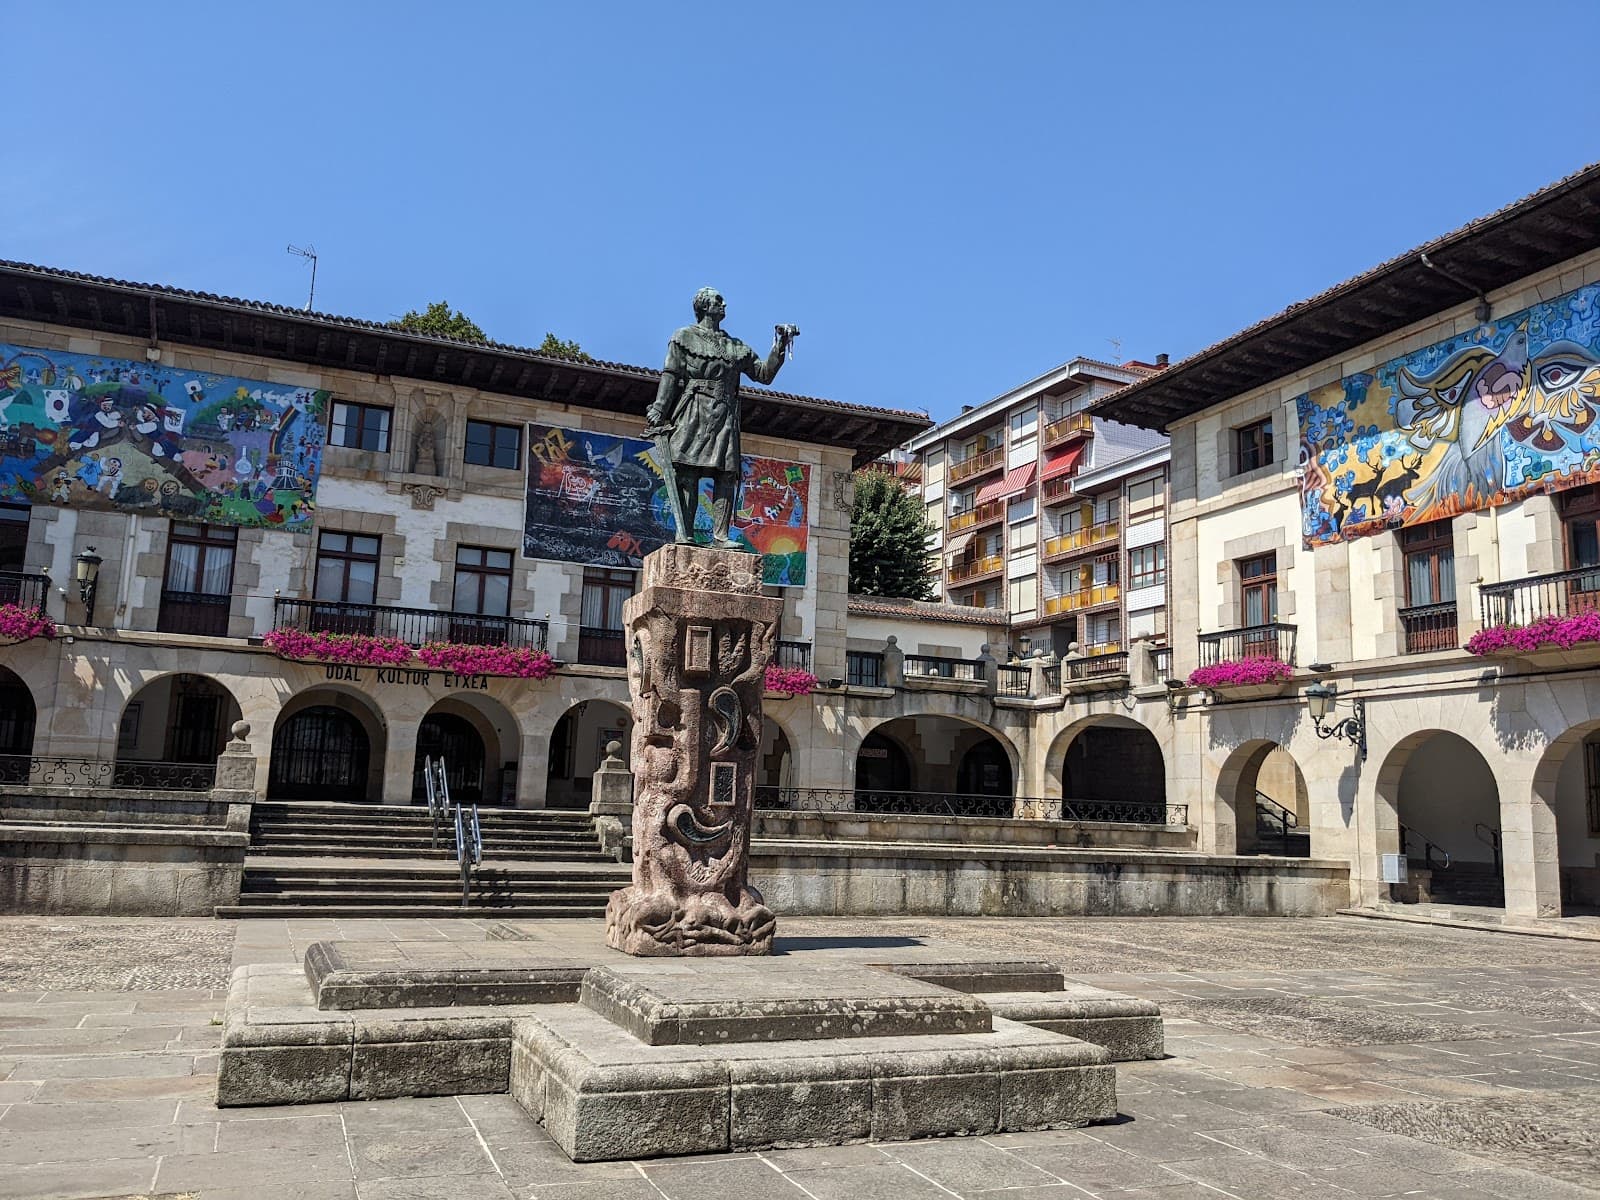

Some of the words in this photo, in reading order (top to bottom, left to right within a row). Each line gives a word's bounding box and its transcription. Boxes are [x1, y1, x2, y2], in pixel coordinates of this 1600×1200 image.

[531, 428, 576, 466] PAZ
[326, 666, 361, 682] UDAL
[377, 670, 430, 686] KULTUR
[444, 675, 489, 689] ETXEA
